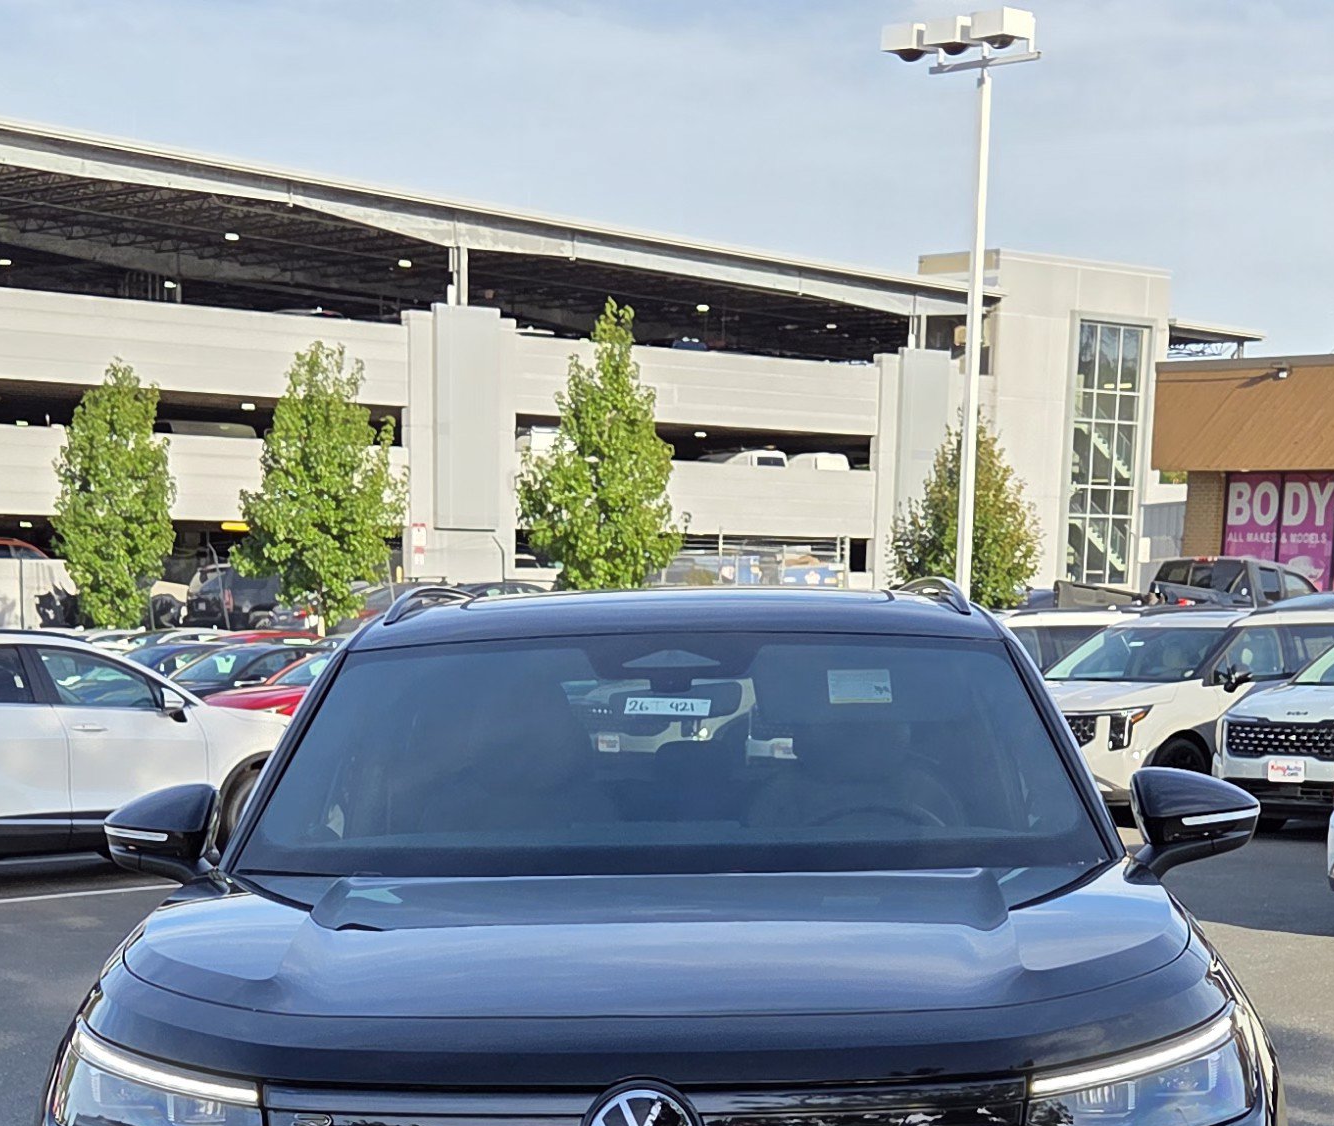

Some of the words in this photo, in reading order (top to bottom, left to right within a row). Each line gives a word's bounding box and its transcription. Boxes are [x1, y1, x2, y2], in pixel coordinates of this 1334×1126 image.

[1227, 532, 1244, 543] ALL
[1246, 532, 1276, 544] MAKES
[1290, 533, 1327, 544] MODELS
